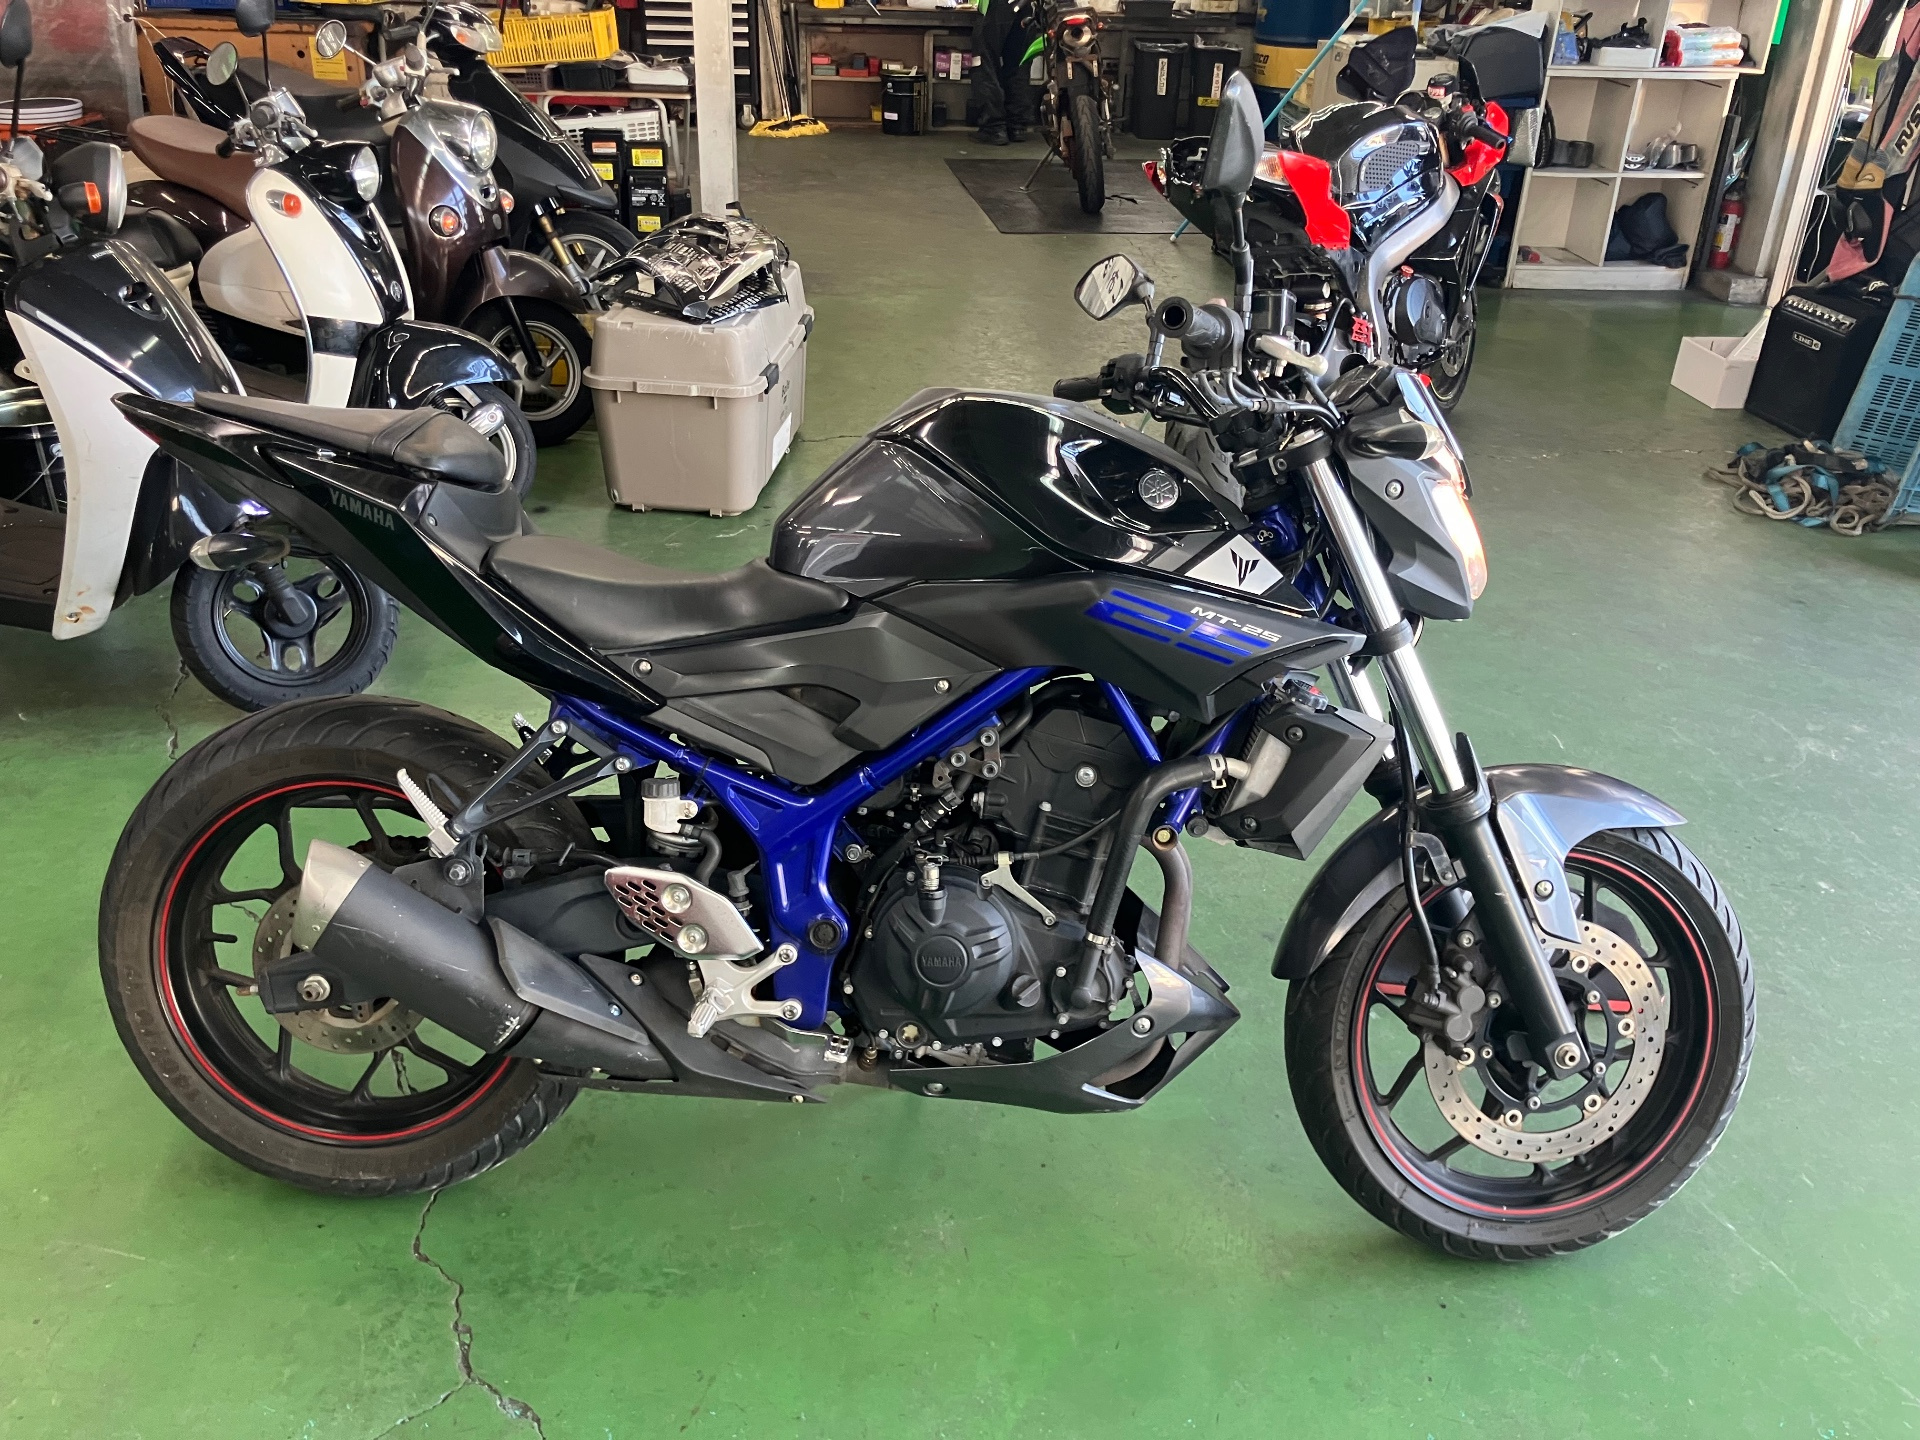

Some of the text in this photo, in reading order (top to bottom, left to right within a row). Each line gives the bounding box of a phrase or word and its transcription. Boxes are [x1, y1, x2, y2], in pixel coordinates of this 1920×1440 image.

[329, 487, 395, 531] YAMAHA
[1190, 606, 1282, 643] MT-25
[921, 955, 962, 967] YAMAHA
